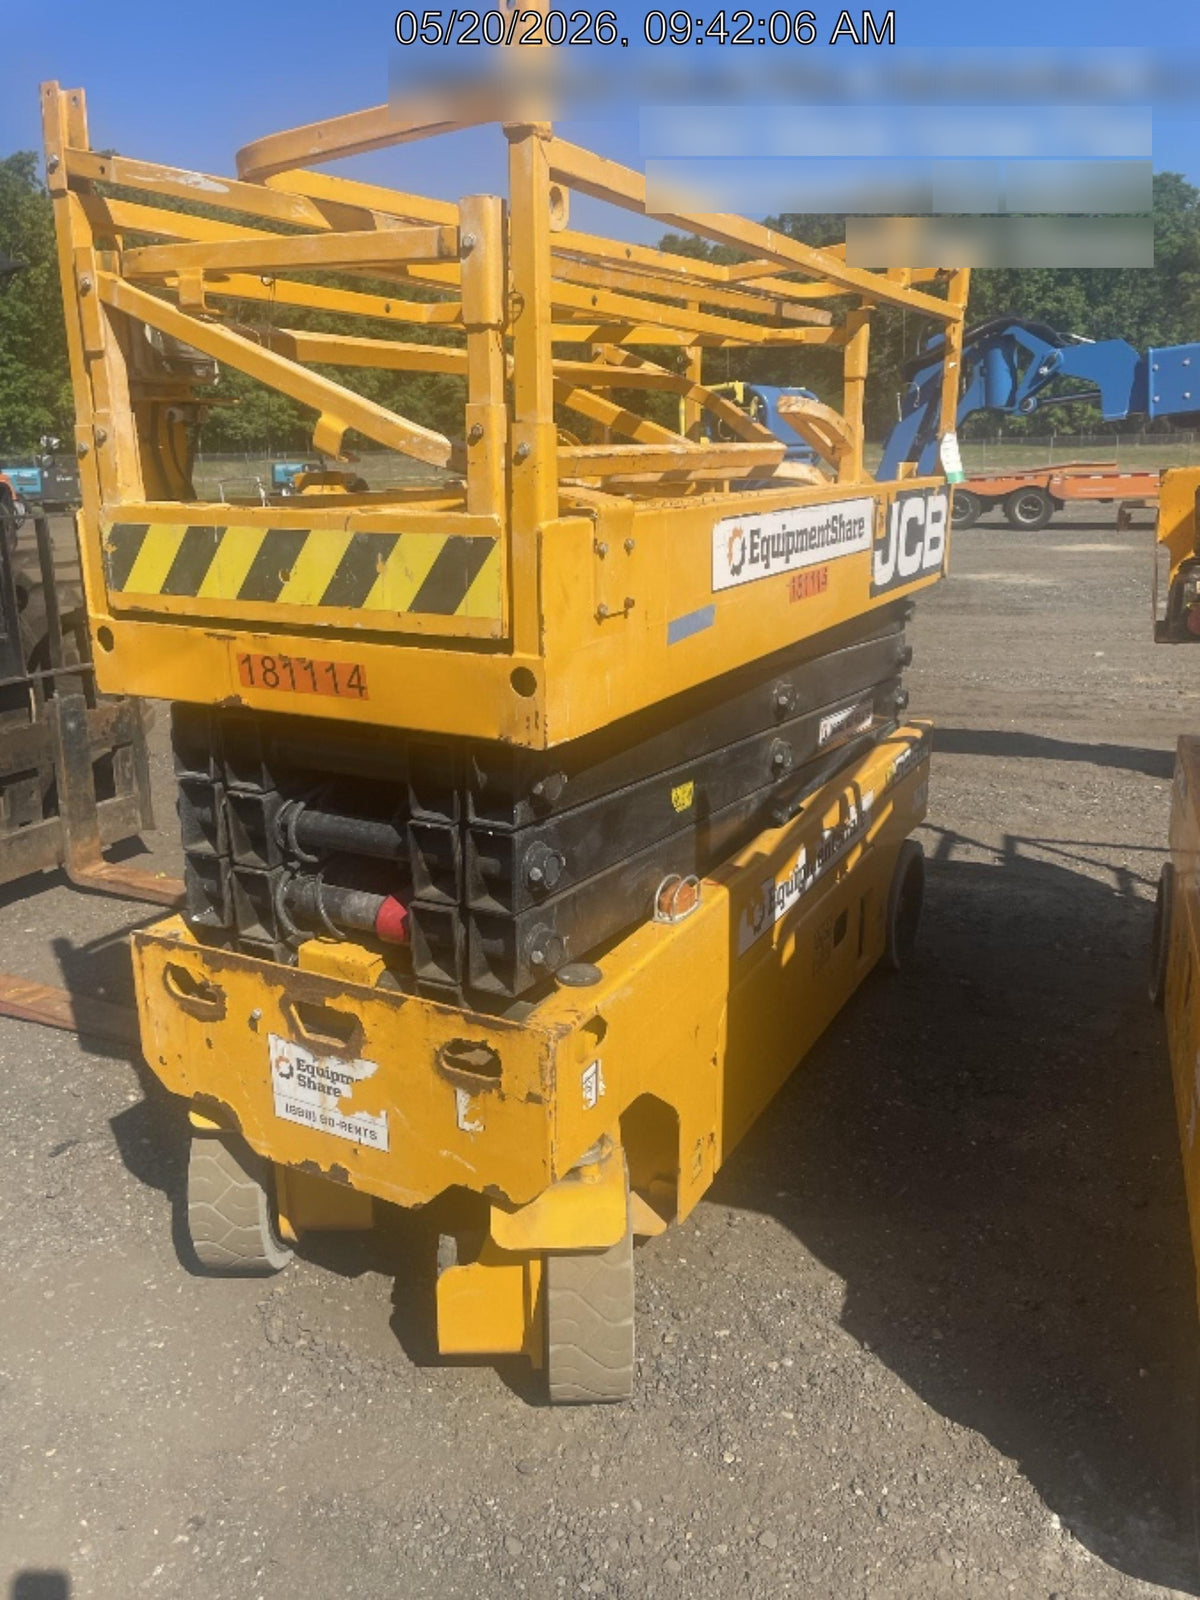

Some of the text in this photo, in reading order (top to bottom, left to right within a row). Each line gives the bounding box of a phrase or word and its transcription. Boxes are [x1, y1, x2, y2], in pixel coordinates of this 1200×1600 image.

[749, 513, 866, 569] EquipmentShare
[874, 494, 948, 586] JCB
[241, 653, 367, 698] 181114
[296, 1057, 363, 1086] Equipm
[297, 1073, 342, 1098] Share
